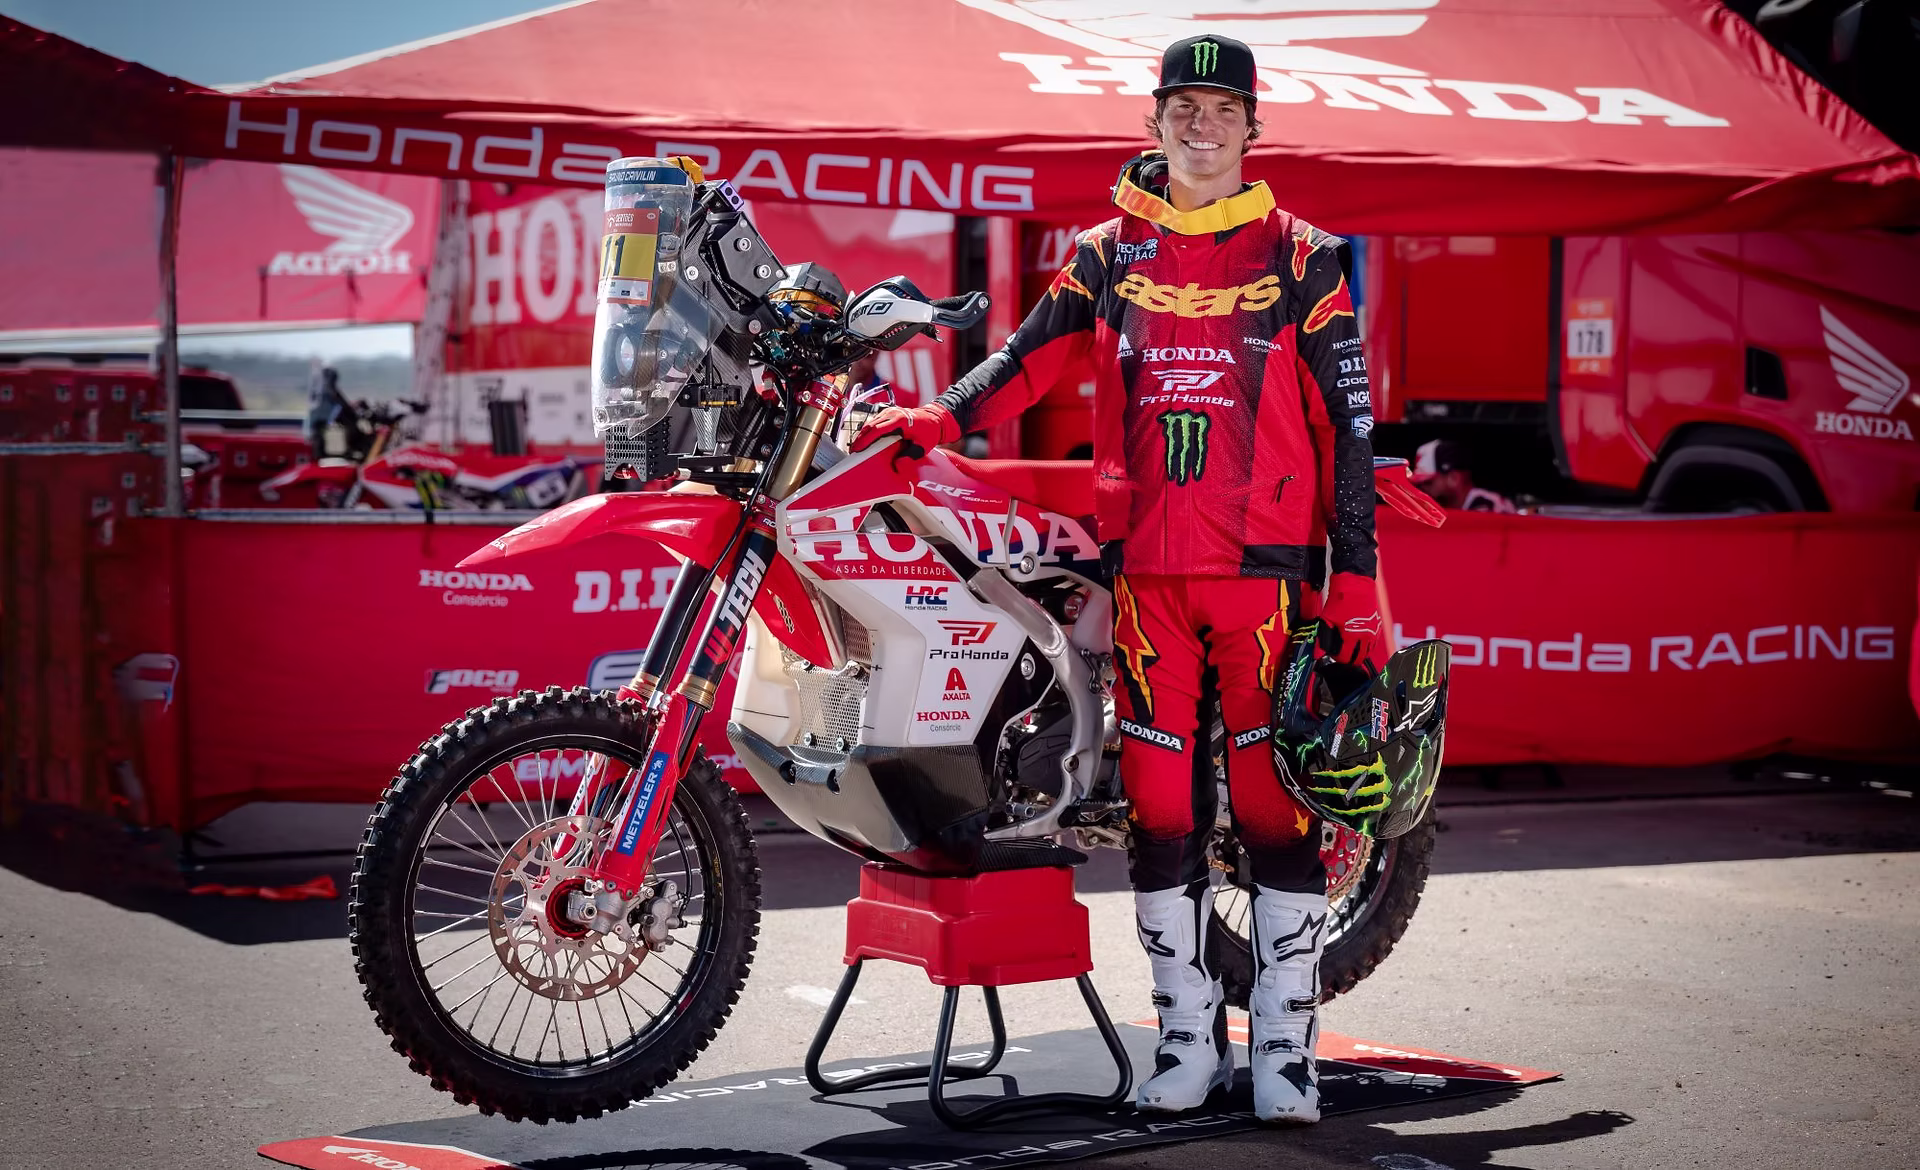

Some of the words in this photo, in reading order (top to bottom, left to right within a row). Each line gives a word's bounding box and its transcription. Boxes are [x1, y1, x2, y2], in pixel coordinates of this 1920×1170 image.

[224, 101, 622, 184] Honda
[655, 141, 1035, 212] RACING
[1113, 273, 1282, 319] astars
[1243, 336, 1283, 351] HONDA
[1142, 347, 1237, 364] HONDA
[1814, 410, 1914, 441] HONDA
[916, 479, 976, 498] CRF
[418, 568, 535, 592] HONDA
[834, 565, 866, 575] ASAS
[871, 565, 887, 575] DA
[892, 565, 947, 577] LIBERDADE
[904, 585, 949, 605] HRC
[1393, 622, 1632, 673] Honda
[1649, 625, 1895, 673] RACING
[942, 692, 971, 701] AXALTA
[916, 710, 971, 722] HONDA
[1120, 719, 1183, 751] HONDA
[621, 771, 658, 851] METZELER
